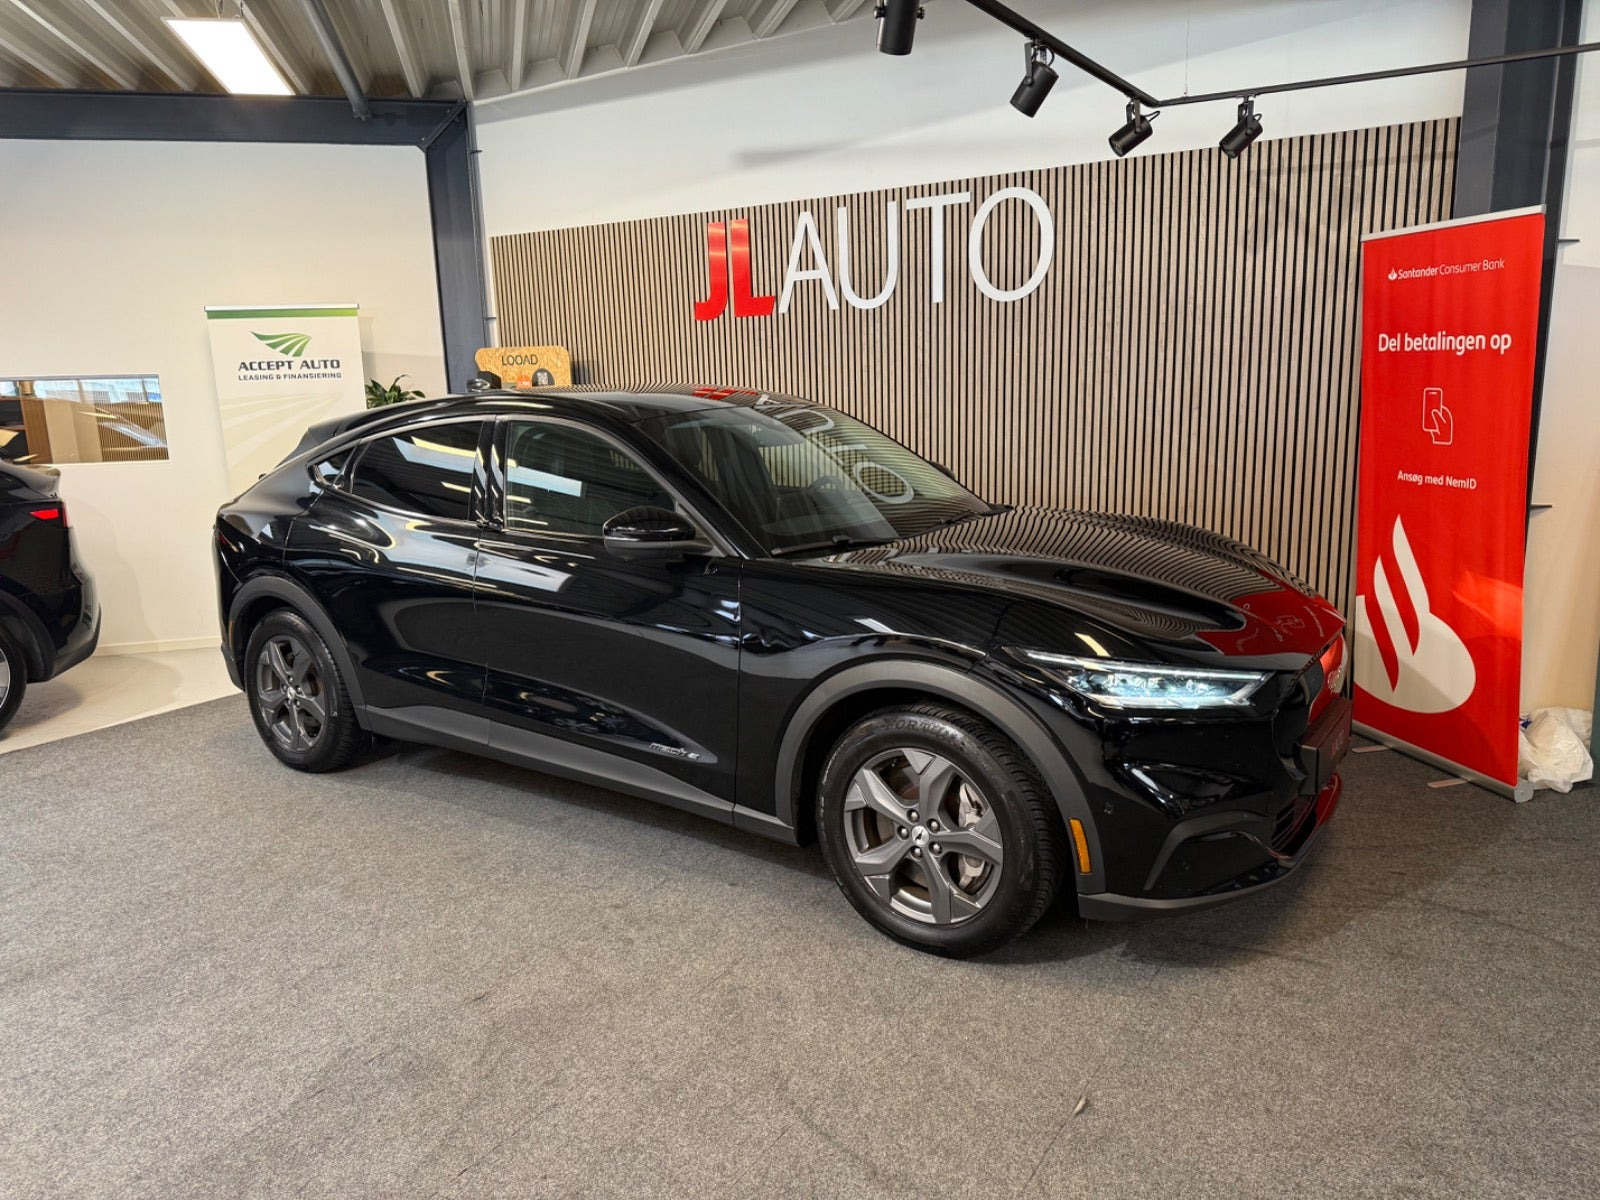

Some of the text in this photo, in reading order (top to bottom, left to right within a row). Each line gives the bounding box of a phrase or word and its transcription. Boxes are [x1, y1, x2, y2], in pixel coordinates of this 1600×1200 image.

[1397, 259, 1505, 279] Santander Consumer Bank
[1378, 331, 1512, 356] Del betalingen op
[238, 360, 341, 371] ACCEPT AUTO
[501, 354, 538, 366] LOOAD
[1397, 470, 1477, 490] Ansøg med NemID
